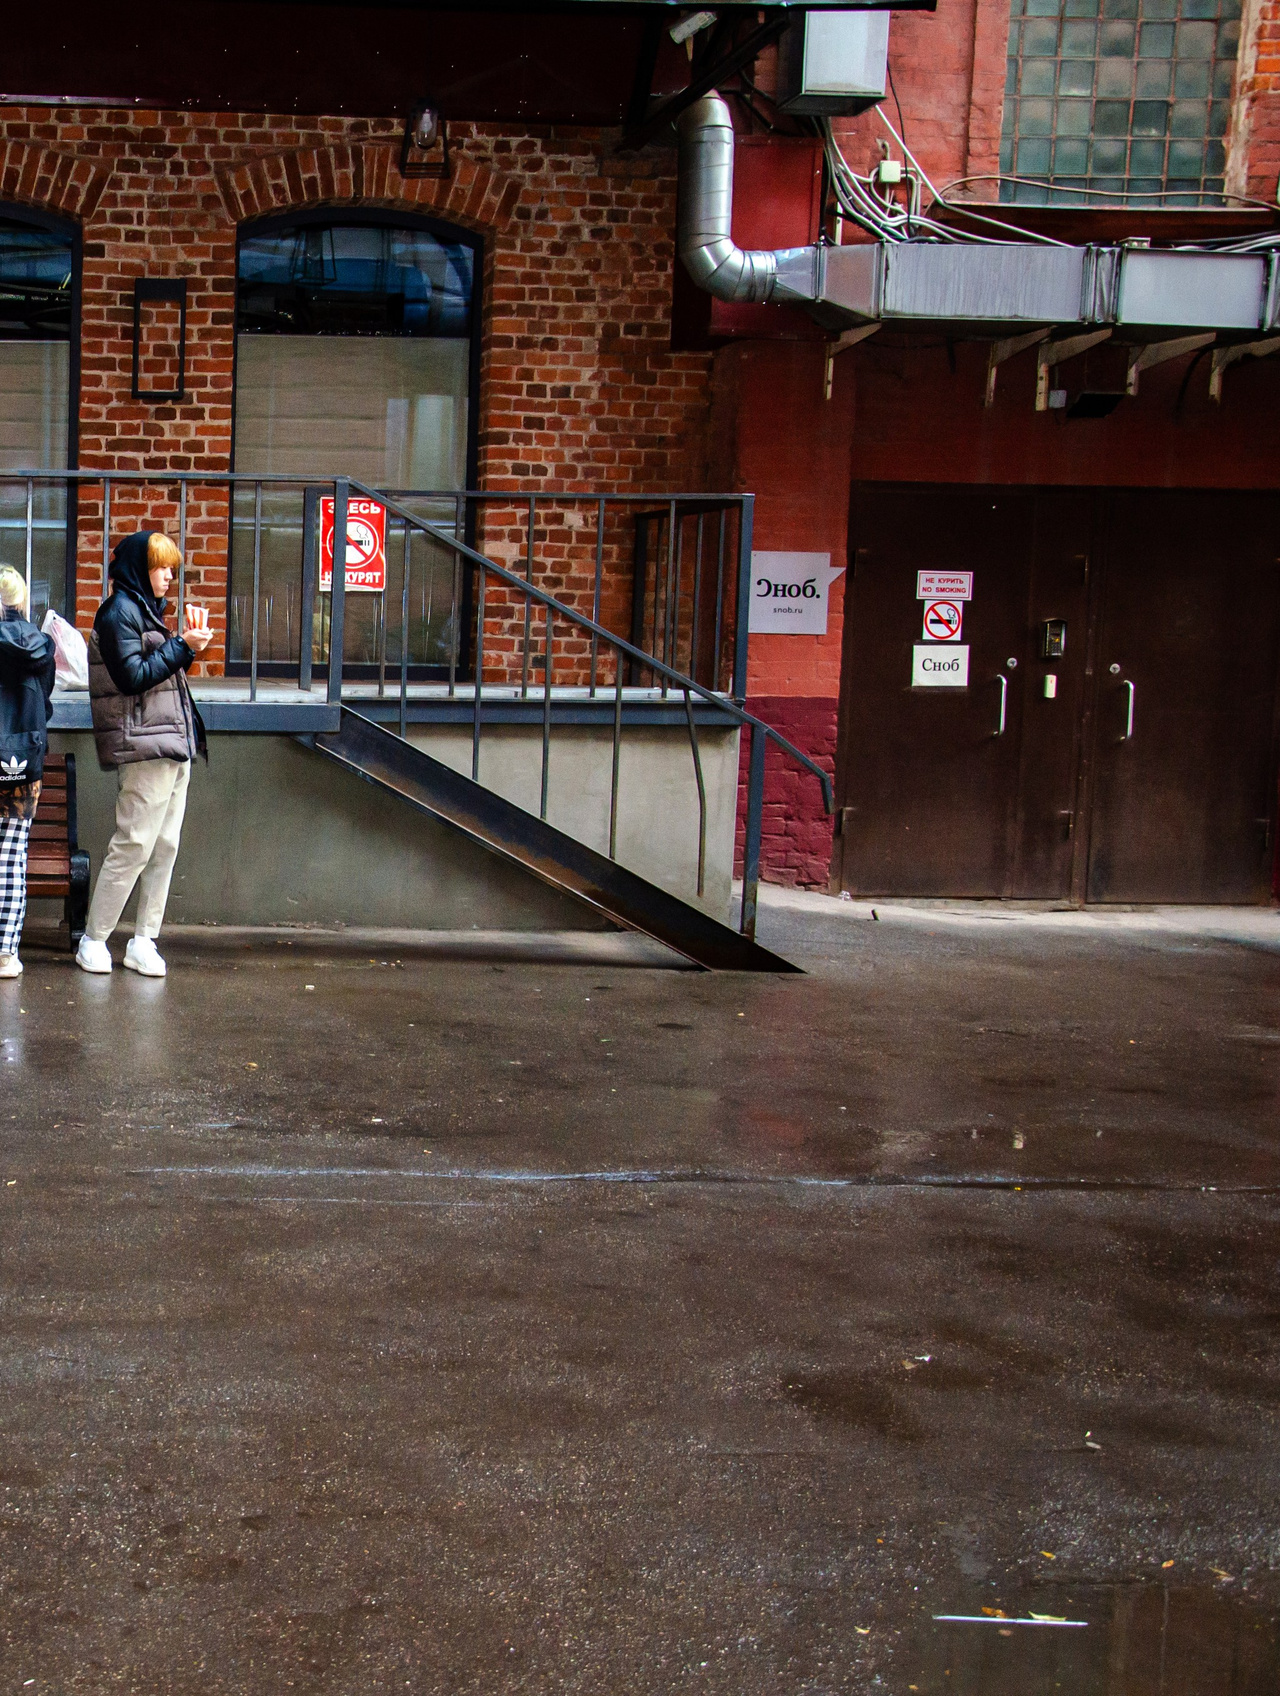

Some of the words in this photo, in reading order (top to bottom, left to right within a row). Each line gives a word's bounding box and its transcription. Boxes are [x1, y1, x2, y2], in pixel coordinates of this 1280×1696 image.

[327, 502, 381, 514] ЗЕСЬ
[938, 577, 964, 585] КУРИТЬ
[773, 606, 803, 614] snob.ru
[922, 657, 960, 671] Сноб
